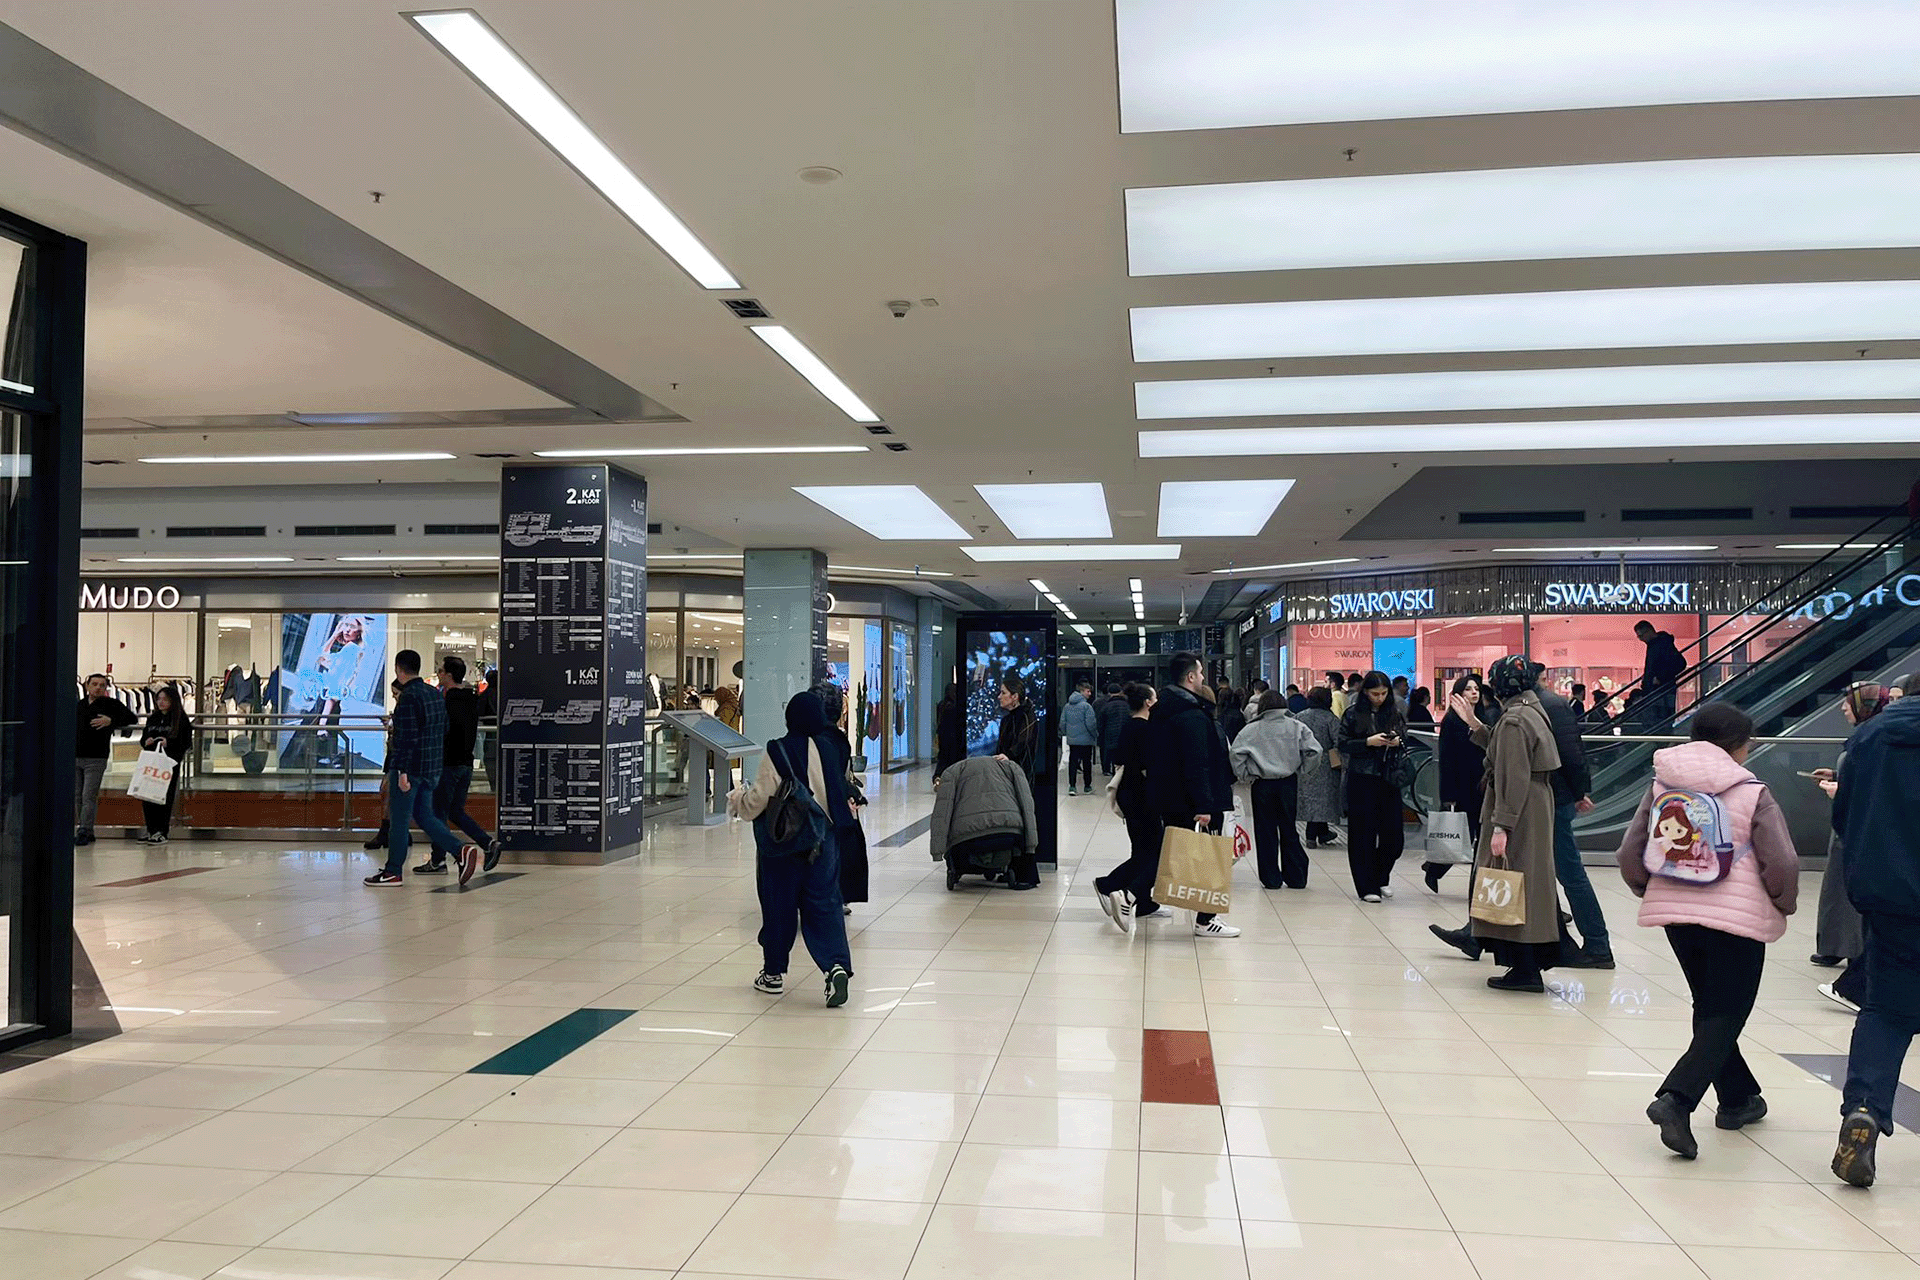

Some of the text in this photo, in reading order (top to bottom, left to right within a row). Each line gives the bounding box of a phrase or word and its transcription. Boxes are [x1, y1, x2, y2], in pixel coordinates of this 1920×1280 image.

[566, 488, 601, 504] 2. KAT
[80, 583, 180, 609] MUDO
[1330, 589, 1434, 614] SWAROVSKI
[1545, 583, 1689, 606] SWAROVSKI
[565, 669, 600, 685] 1. KAT
[143, 766, 172, 780] FLO
[1167, 883, 1229, 907] LEFTIES
